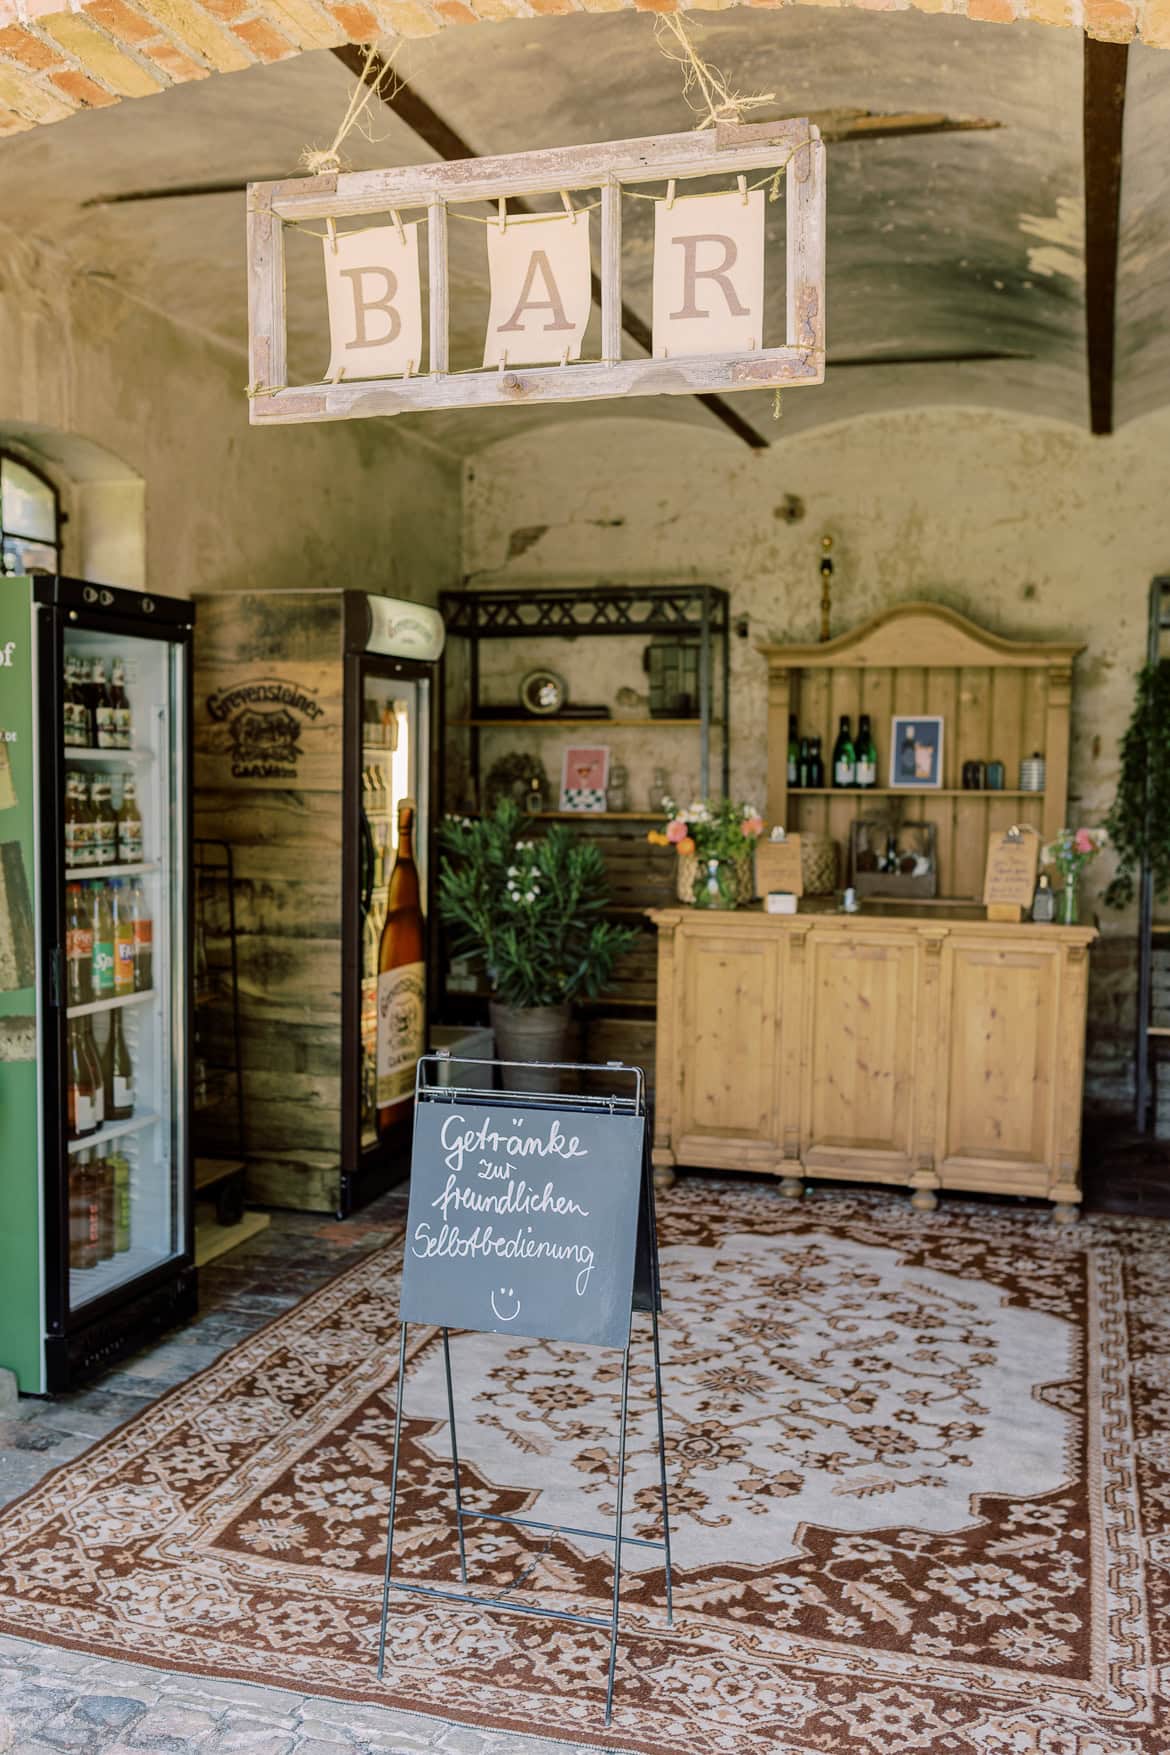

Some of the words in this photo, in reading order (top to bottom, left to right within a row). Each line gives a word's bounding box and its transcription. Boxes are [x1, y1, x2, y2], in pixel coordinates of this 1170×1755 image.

[339, 233, 750, 350] BAR
[206, 683, 325, 721] Grevensteiner
[441, 1115, 588, 1171] Getränke
[477, 1159, 517, 1180] zur
[432, 1174, 589, 1220] freundlichen
[412, 1223, 595, 1296] Selbstbedienung
